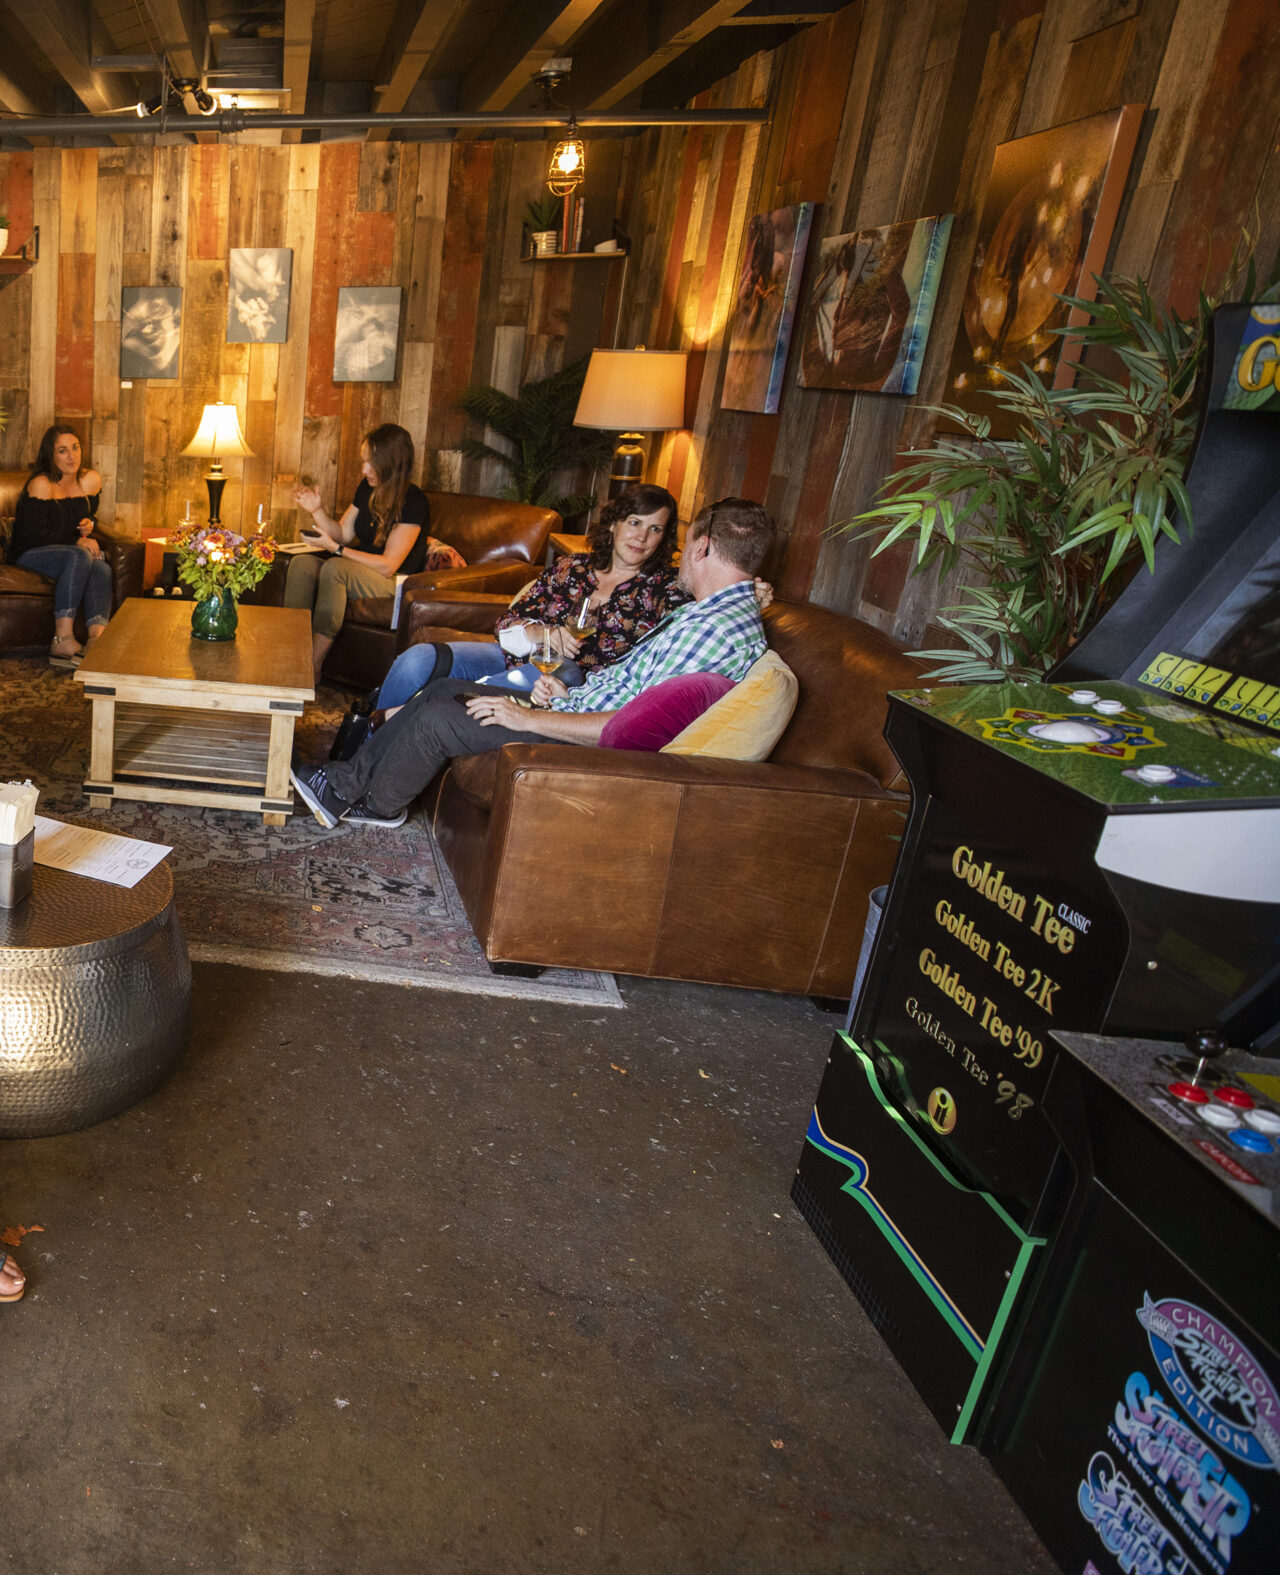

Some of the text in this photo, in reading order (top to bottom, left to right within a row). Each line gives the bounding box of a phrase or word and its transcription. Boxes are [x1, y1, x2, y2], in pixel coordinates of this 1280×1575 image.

[1238, 336, 1280, 392] G
[952, 845, 1075, 954] Golden Tee
[1057, 903, 1091, 934] CLASSIC
[935, 900, 1062, 1016] Golden Tee 2K
[919, 948, 1043, 1070] Golden Tee '99
[905, 997, 1035, 1121] Golden Tee '98
[1172, 1308, 1277, 1417] CHAMPION
[1174, 1327, 1238, 1378] STREET
[1183, 1350, 1257, 1426] FIGHTER
[1130, 1395, 1224, 1473] STREET
[1162, 1357, 1249, 1455] EDITION
[1107, 1424, 1127, 1455] The
[1127, 1452, 1154, 1487] New
[1127, 1417, 1203, 1506] FIGHTER
[1094, 1479, 1186, 1563] STREET
